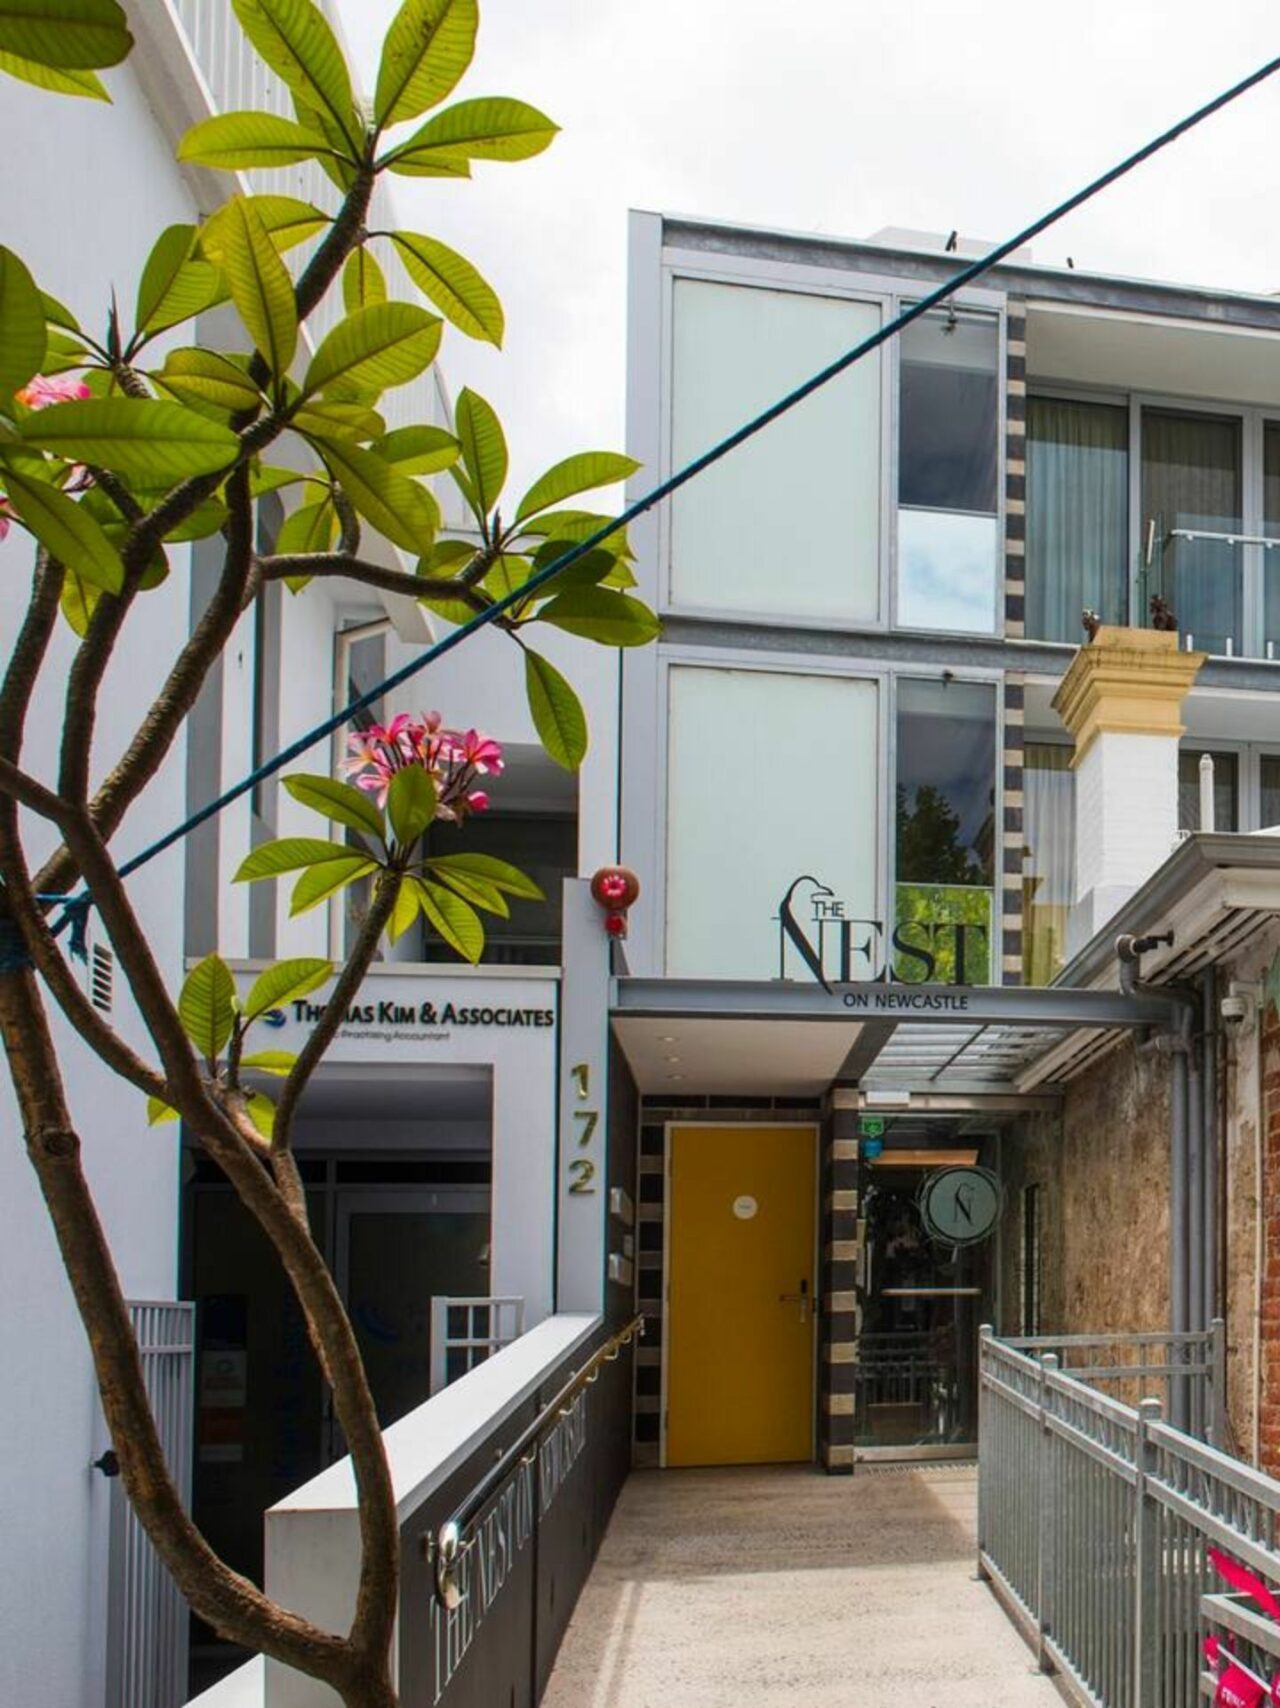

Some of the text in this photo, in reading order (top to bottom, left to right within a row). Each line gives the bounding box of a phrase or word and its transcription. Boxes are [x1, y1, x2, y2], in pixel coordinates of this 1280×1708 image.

[811, 901, 845, 919] THE
[770, 877, 988, 994] NEST
[843, 993, 968, 1011] ON NEWCASTLE
[420, 1003, 437, 1025] &
[568, 1064, 599, 1197] 172
